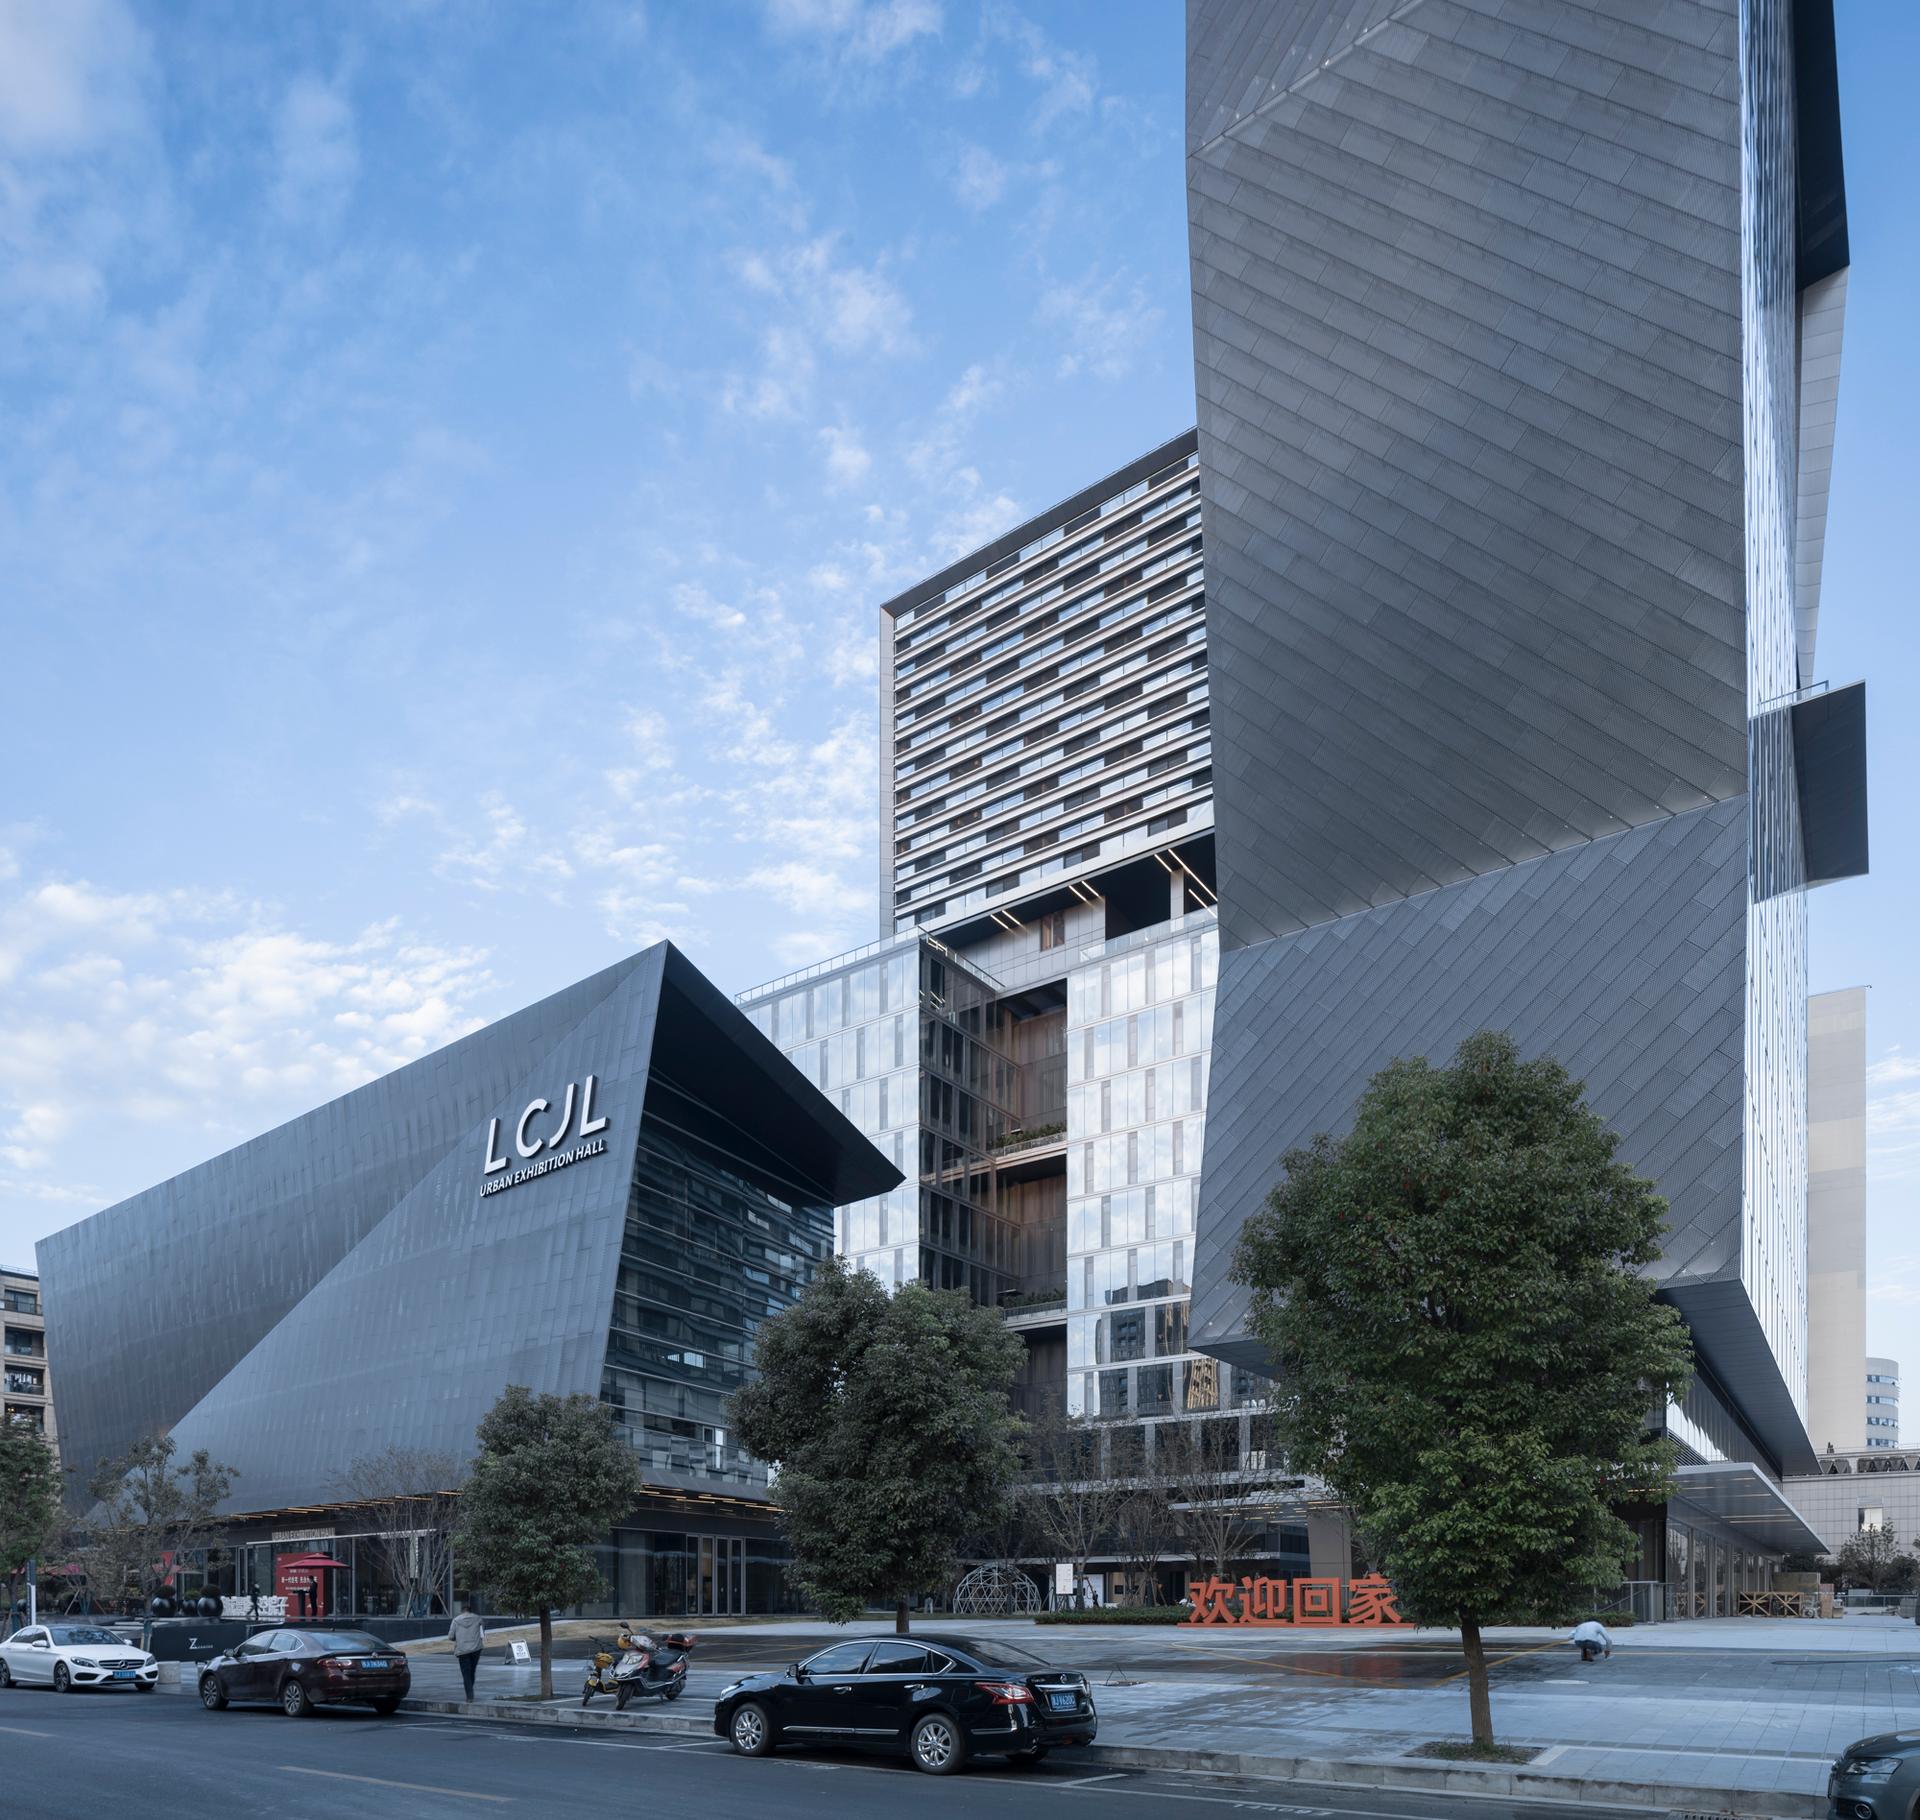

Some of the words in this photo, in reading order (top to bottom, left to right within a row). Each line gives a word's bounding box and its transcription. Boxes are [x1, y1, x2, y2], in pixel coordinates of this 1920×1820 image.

[484, 1074, 608, 1175] LCJL
[479, 1174, 514, 1197] URBAN
[514, 1149, 575, 1184] EXHIBITION
[575, 1138, 605, 1161] HALL
[1188, 1573, 1402, 1625] 欢迎回家
